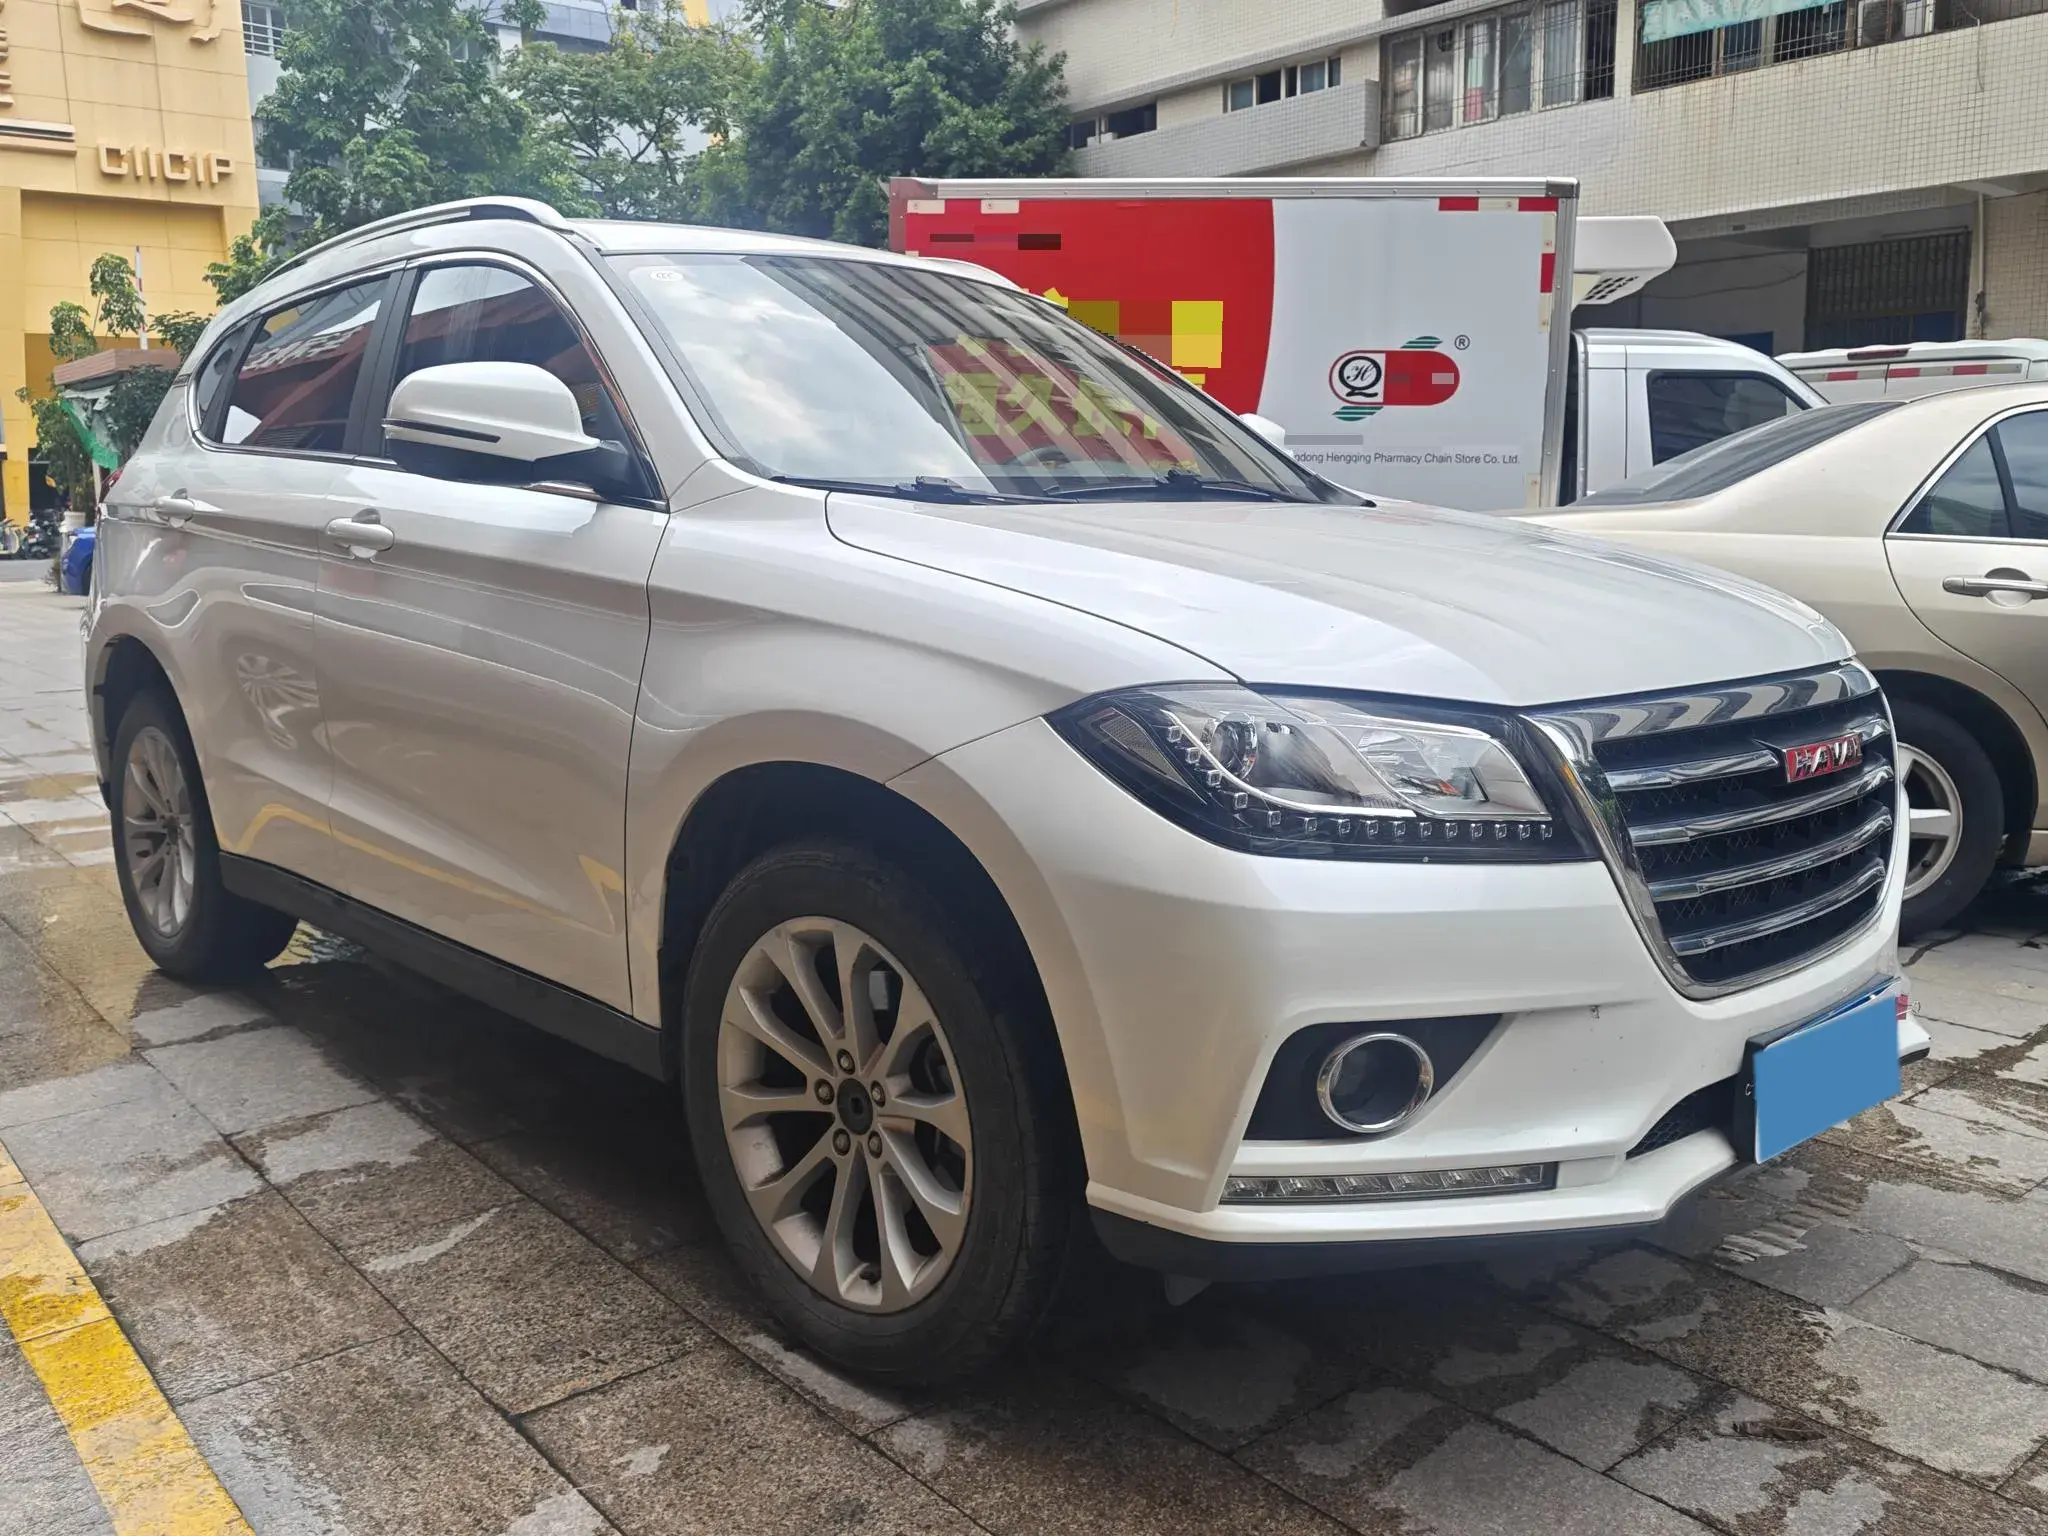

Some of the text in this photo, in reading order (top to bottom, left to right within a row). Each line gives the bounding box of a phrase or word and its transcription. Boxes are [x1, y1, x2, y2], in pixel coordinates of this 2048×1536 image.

[1326, 452, 1372, 465] Hengqing
[1374, 452, 1422, 465] Pharmacy
[1424, 453, 1453, 464] Chain
[1454, 453, 1481, 464] Store
